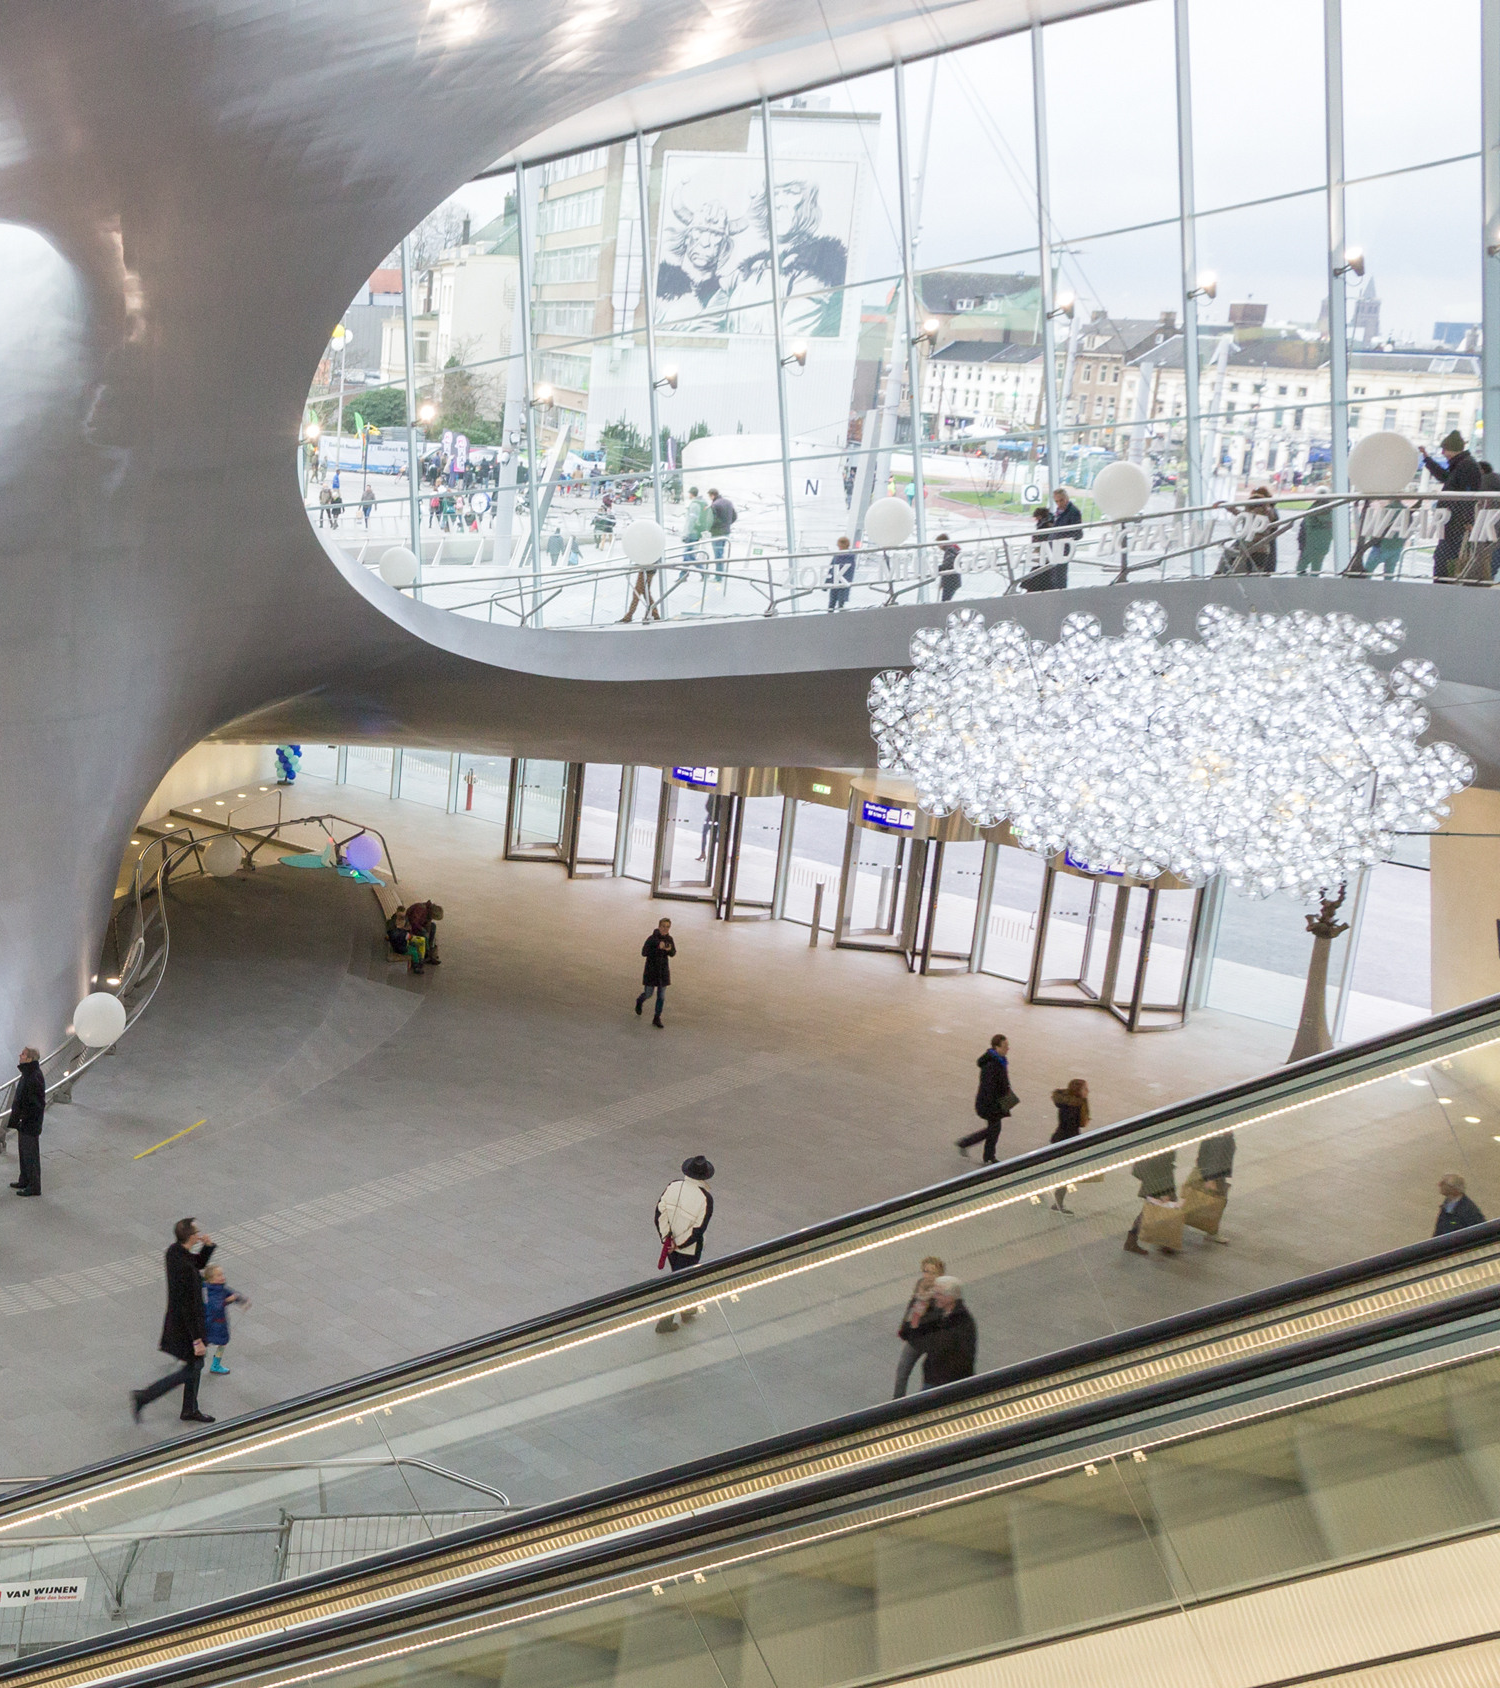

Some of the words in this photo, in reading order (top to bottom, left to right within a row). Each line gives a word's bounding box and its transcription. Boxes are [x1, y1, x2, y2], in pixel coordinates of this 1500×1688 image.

[805, 479, 819, 495] N
[1024, 485, 1040, 502] Q
[781, 563, 852, 590] ZOEK
[878, 551, 940, 582] MIJN
[954, 539, 1077, 574] GOLVEND
[1097, 518, 1217, 557] LICHAAM
[1230, 511, 1270, 542] OP
[1361, 507, 1452, 539] WAAR
[1469, 508, 1500, 542] IK
[6, 1589, 30, 1598] VAN
[34, 1586, 78, 1595] WIJNEN
